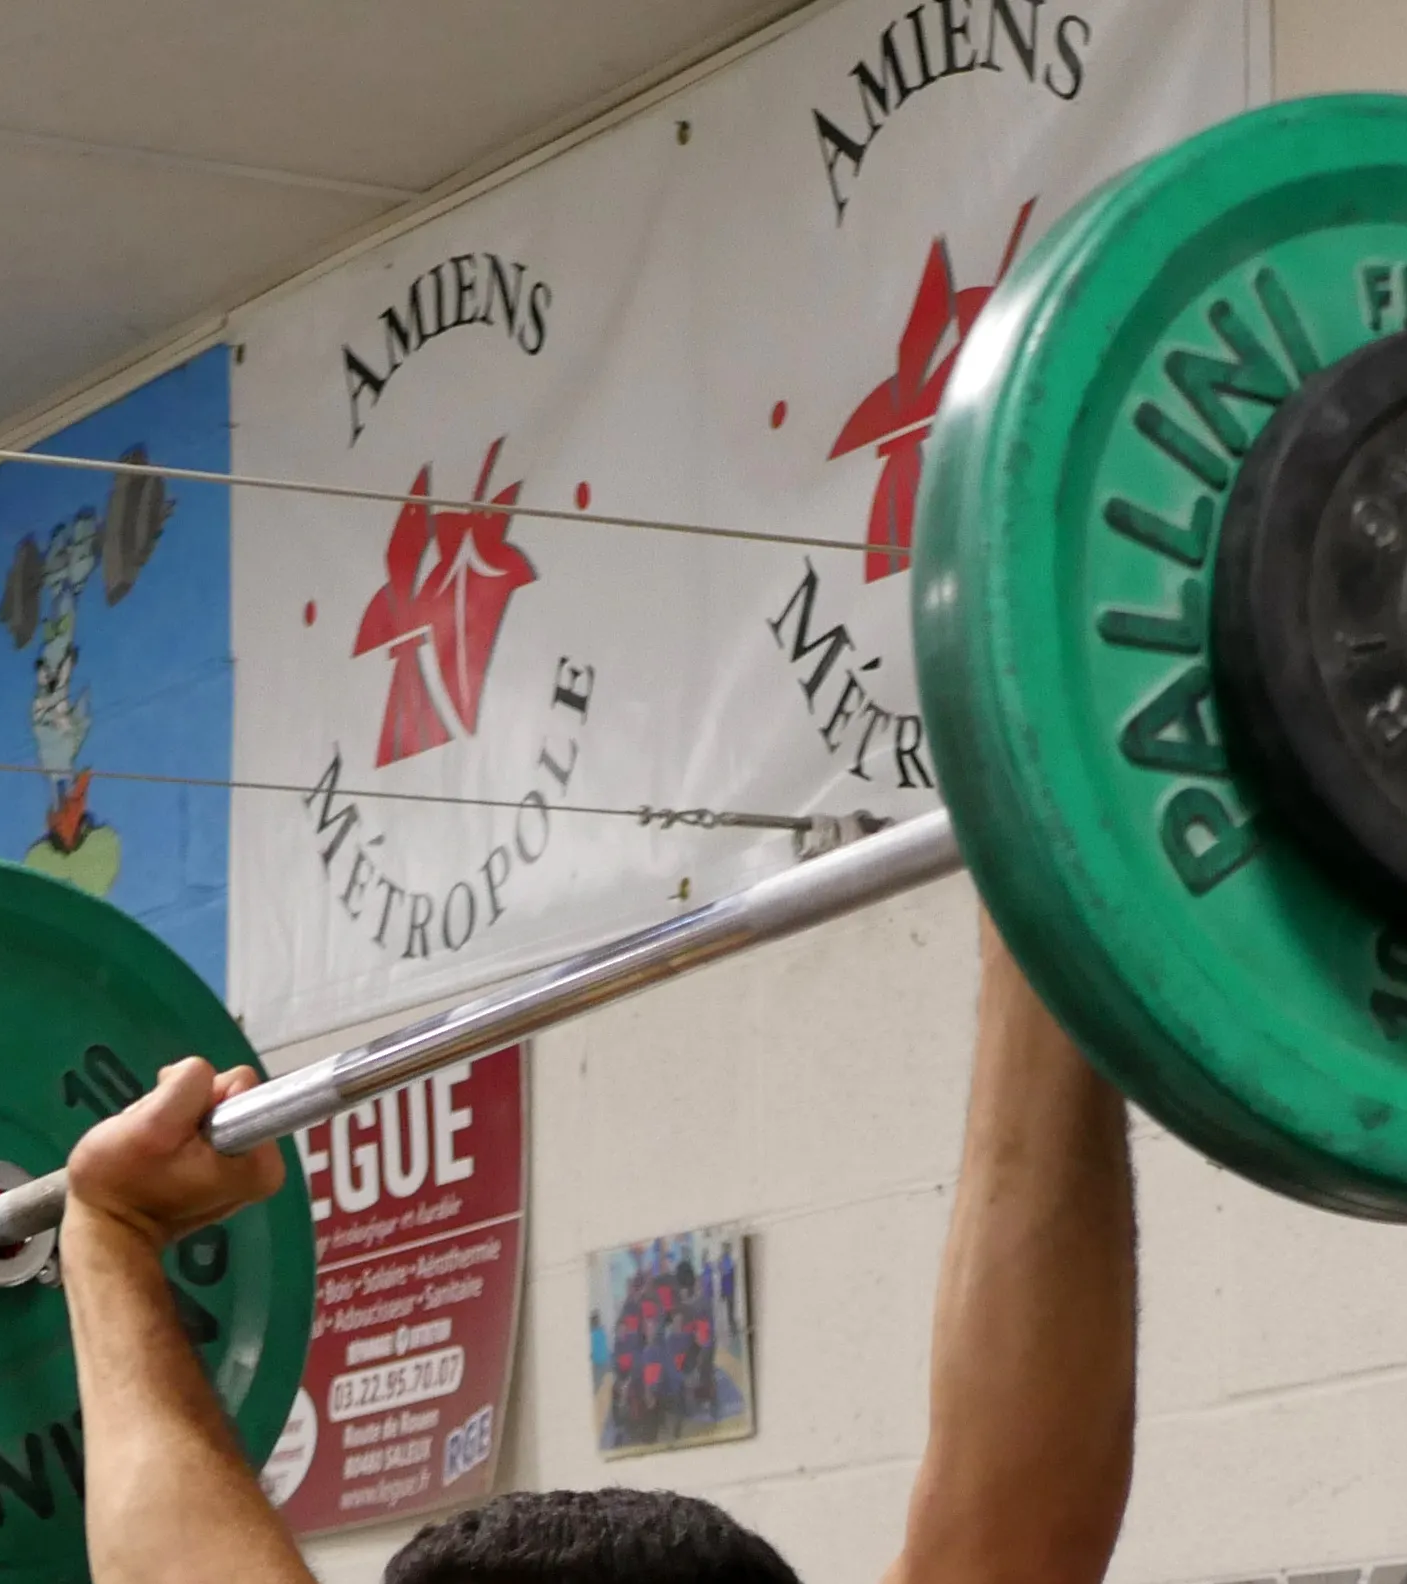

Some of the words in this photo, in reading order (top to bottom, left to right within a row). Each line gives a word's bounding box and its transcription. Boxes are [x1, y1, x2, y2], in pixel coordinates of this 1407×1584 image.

[810, 0, 1092, 227] AMIENS
[341, 253, 552, 448] AMIENS
[1097, 268, 1323, 898] PALLINI
[302, 656, 595, 960] MÉTROPOLE
